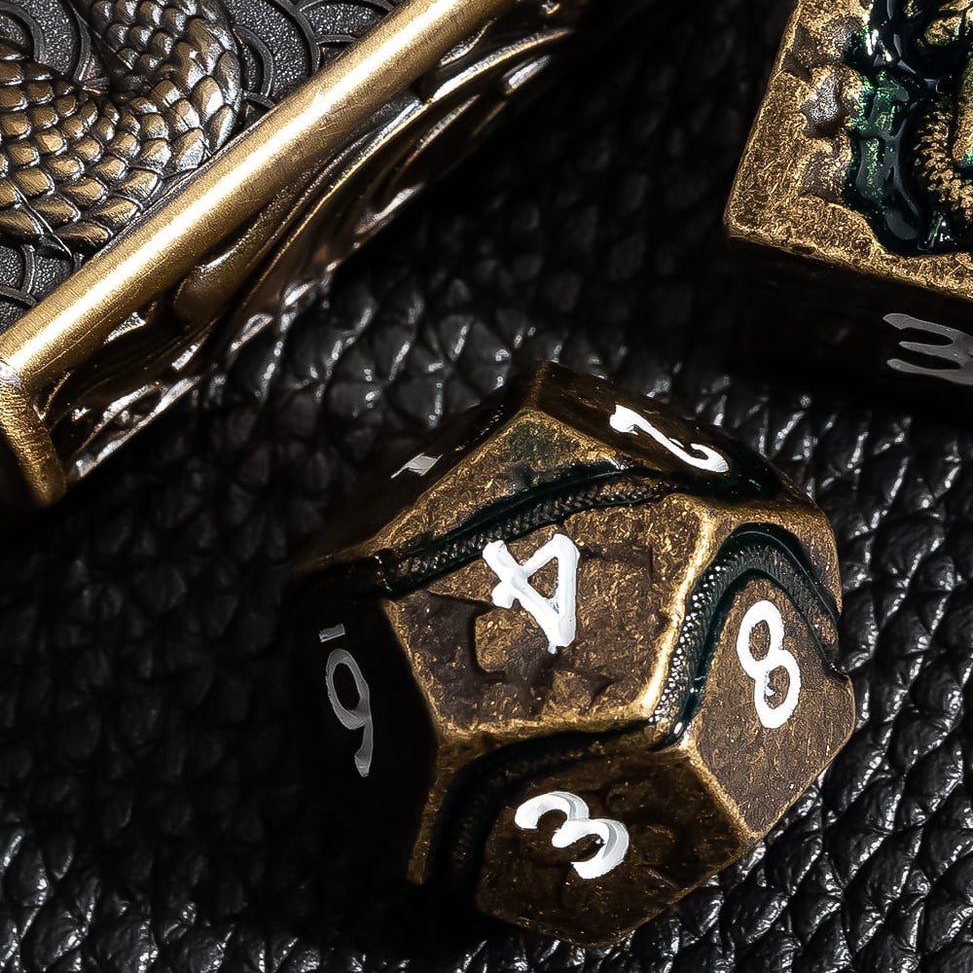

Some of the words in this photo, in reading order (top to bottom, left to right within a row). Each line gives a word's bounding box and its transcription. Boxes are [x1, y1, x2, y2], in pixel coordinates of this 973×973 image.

[483, 534, 580, 654] 4
[737, 600, 801, 728] 8
[515, 791, 629, 879] 3
